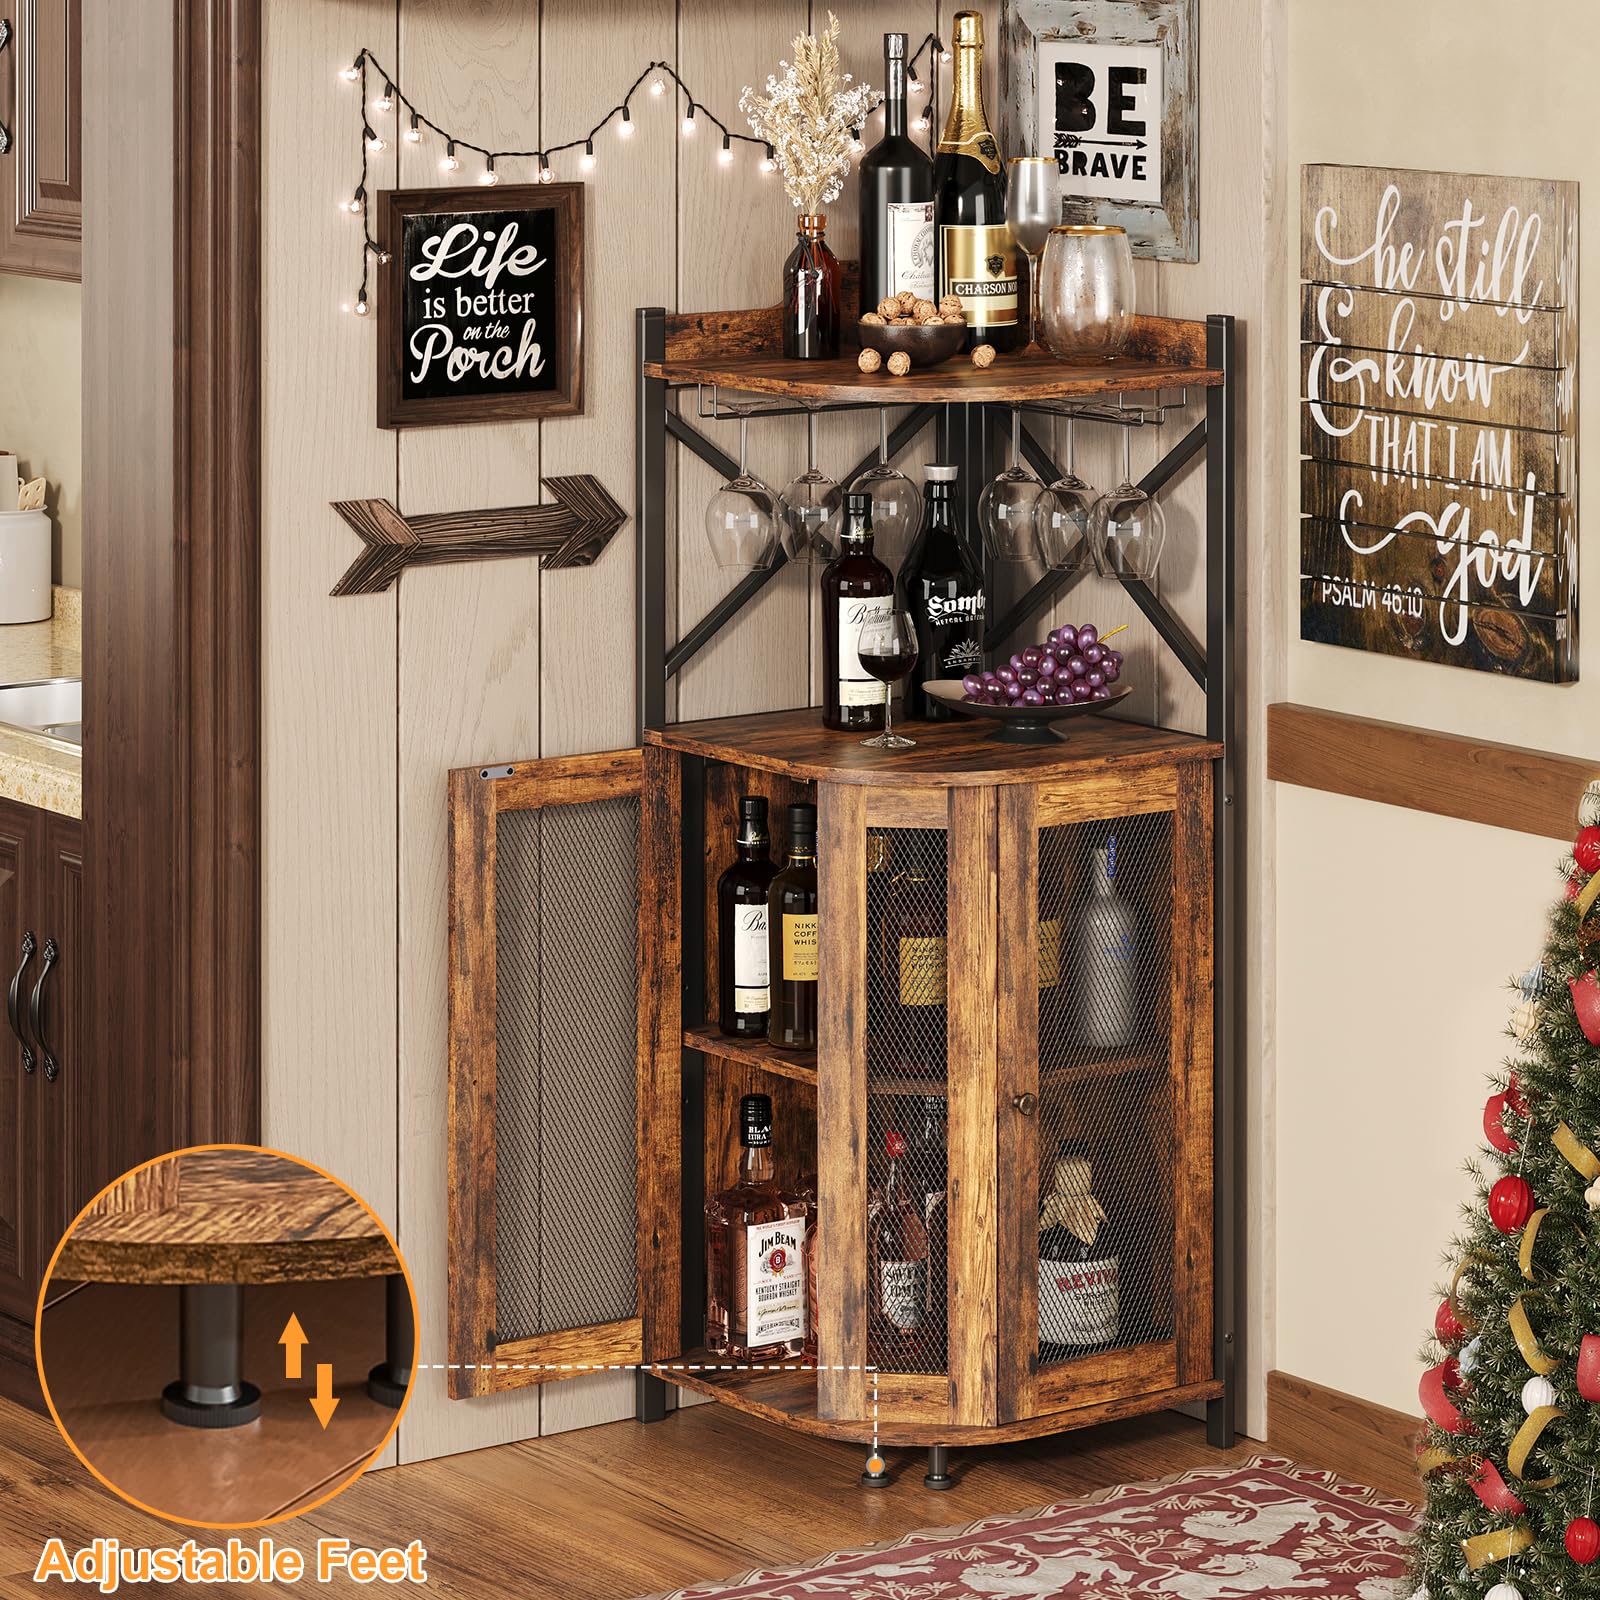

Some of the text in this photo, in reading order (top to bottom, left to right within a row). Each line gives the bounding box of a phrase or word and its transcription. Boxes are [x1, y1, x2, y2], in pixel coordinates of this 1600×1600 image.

[1054, 62, 1147, 136] BE
[1054, 149, 1147, 180] BRAVE
[410, 222, 547, 289] Life
[1315, 184, 1543, 324] be still
[423, 286, 535, 319] is better
[956, 282, 1007, 295] CHARSON
[410, 318, 546, 384] Porch
[463, 320, 510, 340] on the
[1386, 298, 1529, 410] know
[1364, 414, 1517, 516] THAT I AM
[1340, 472, 1544, 646] god
[1322, 575, 1423, 618] PSALM 46:10
[758, 1231, 796, 1258] JIM BEAM
[756, 1280, 800, 1295] KENTUCKY STRAIGHT
[759, 1289, 797, 1302] BOURBON WHISKEY
